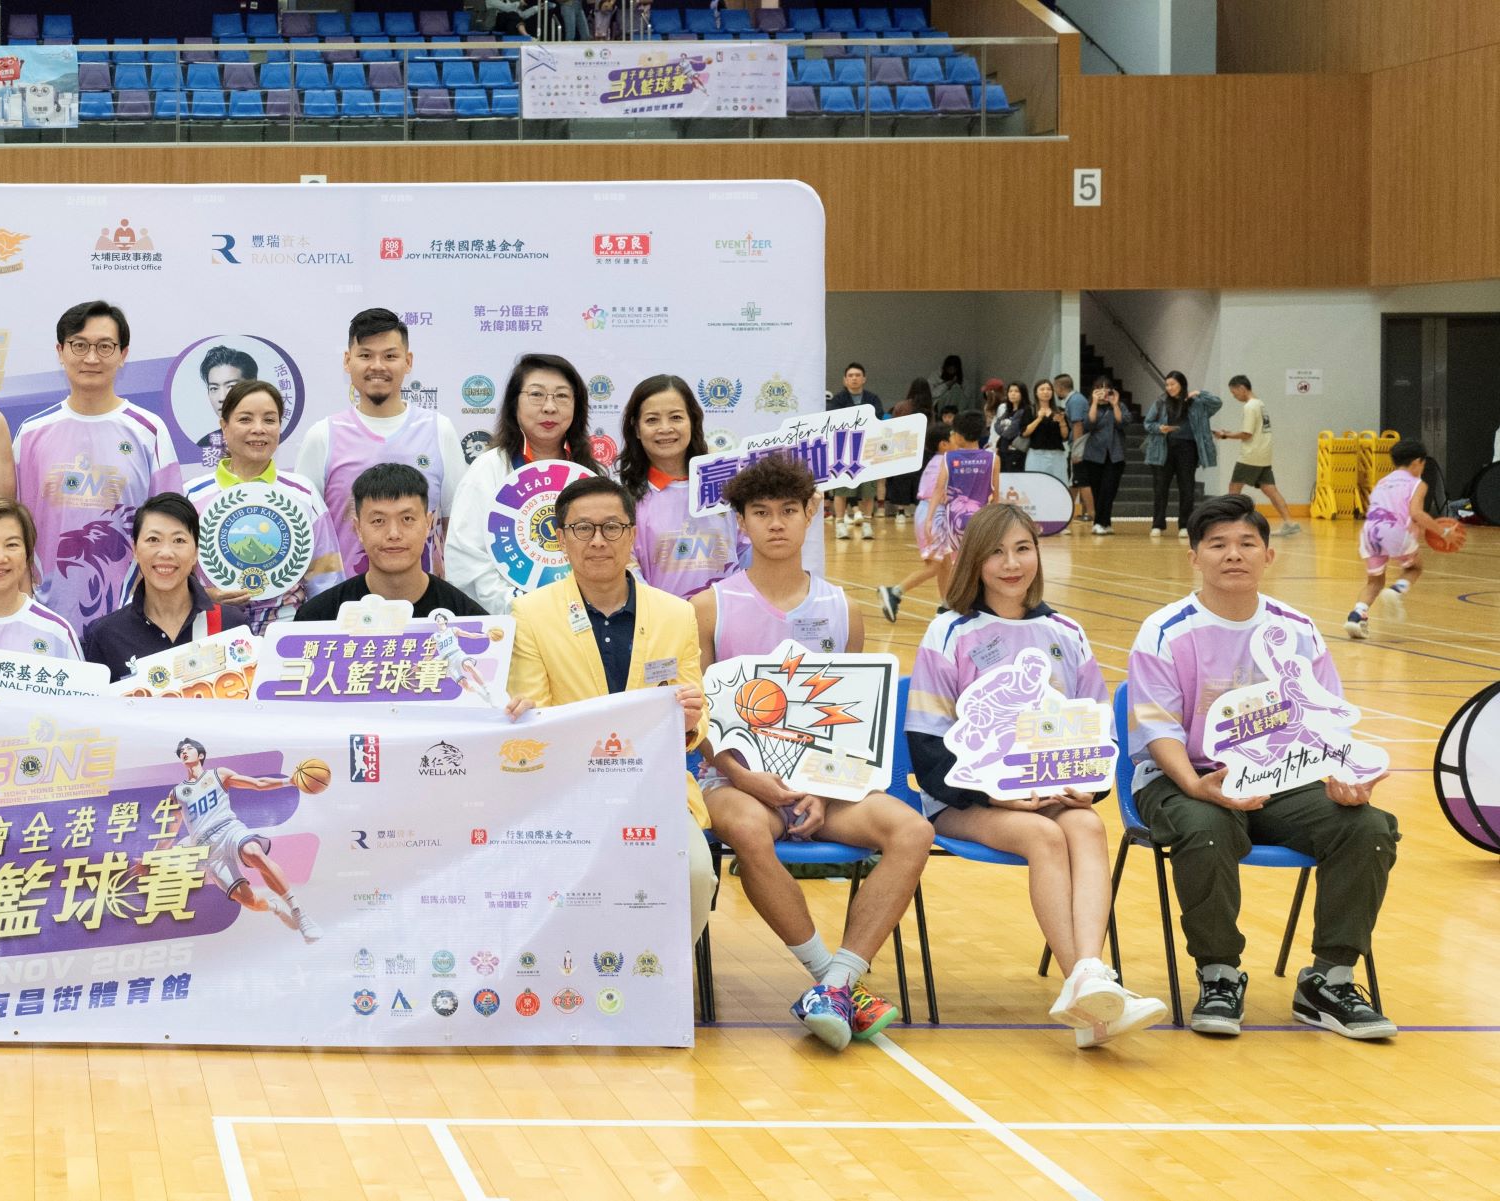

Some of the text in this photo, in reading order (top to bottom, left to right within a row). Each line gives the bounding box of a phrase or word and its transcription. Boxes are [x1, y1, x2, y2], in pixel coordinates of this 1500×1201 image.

[1079, 173, 1097, 201] 5
[430, 238, 525, 253] 行樂國際基金會
[599, 235, 644, 250] 馬百良
[90, 252, 163, 262] 大埔民政事務處
[114, 263, 140, 271] District
[141, 263, 162, 271] Office
[404, 252, 549, 260] JOY INTERNATIONAL FOUNDATION
[473, 305, 549, 317] 第一分區主席
[747, 409, 868, 451] monster dunk
[516, 476, 552, 497] LEAD
[220, 506, 290, 557] LIONS CLUB OF KAU TO SHAN
[500, 525, 525, 569] SERVE
[302, 638, 438, 659] 獅子會全港學生
[275, 659, 449, 696] 3人籃球賽
[367, 736, 377, 780] BAHKC
[187, 789, 219, 822] 303
[0, 951, 75, 984] NOV
[91, 941, 195, 976] 2025
